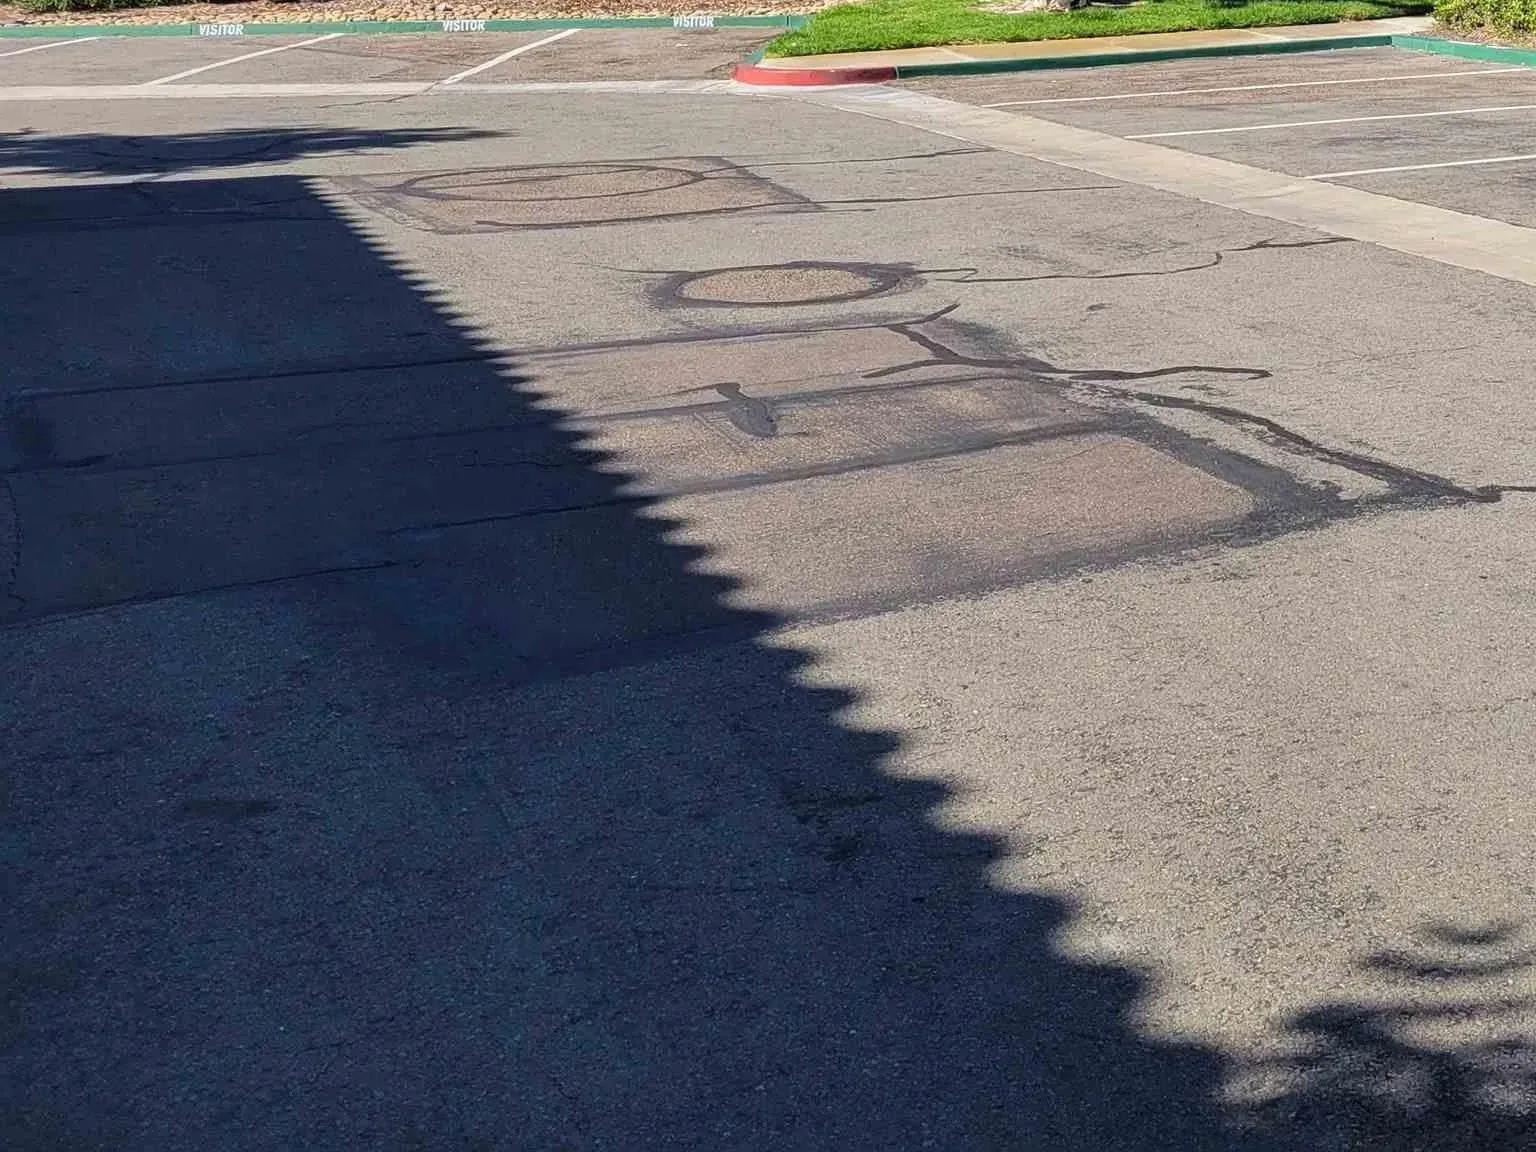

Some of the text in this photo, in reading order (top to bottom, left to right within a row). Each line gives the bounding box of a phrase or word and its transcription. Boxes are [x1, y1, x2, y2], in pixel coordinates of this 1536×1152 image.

[443, 19, 486, 32] VISITOR
[673, 16, 714, 28] VISITOR
[199, 23, 245, 35] VISITOR
